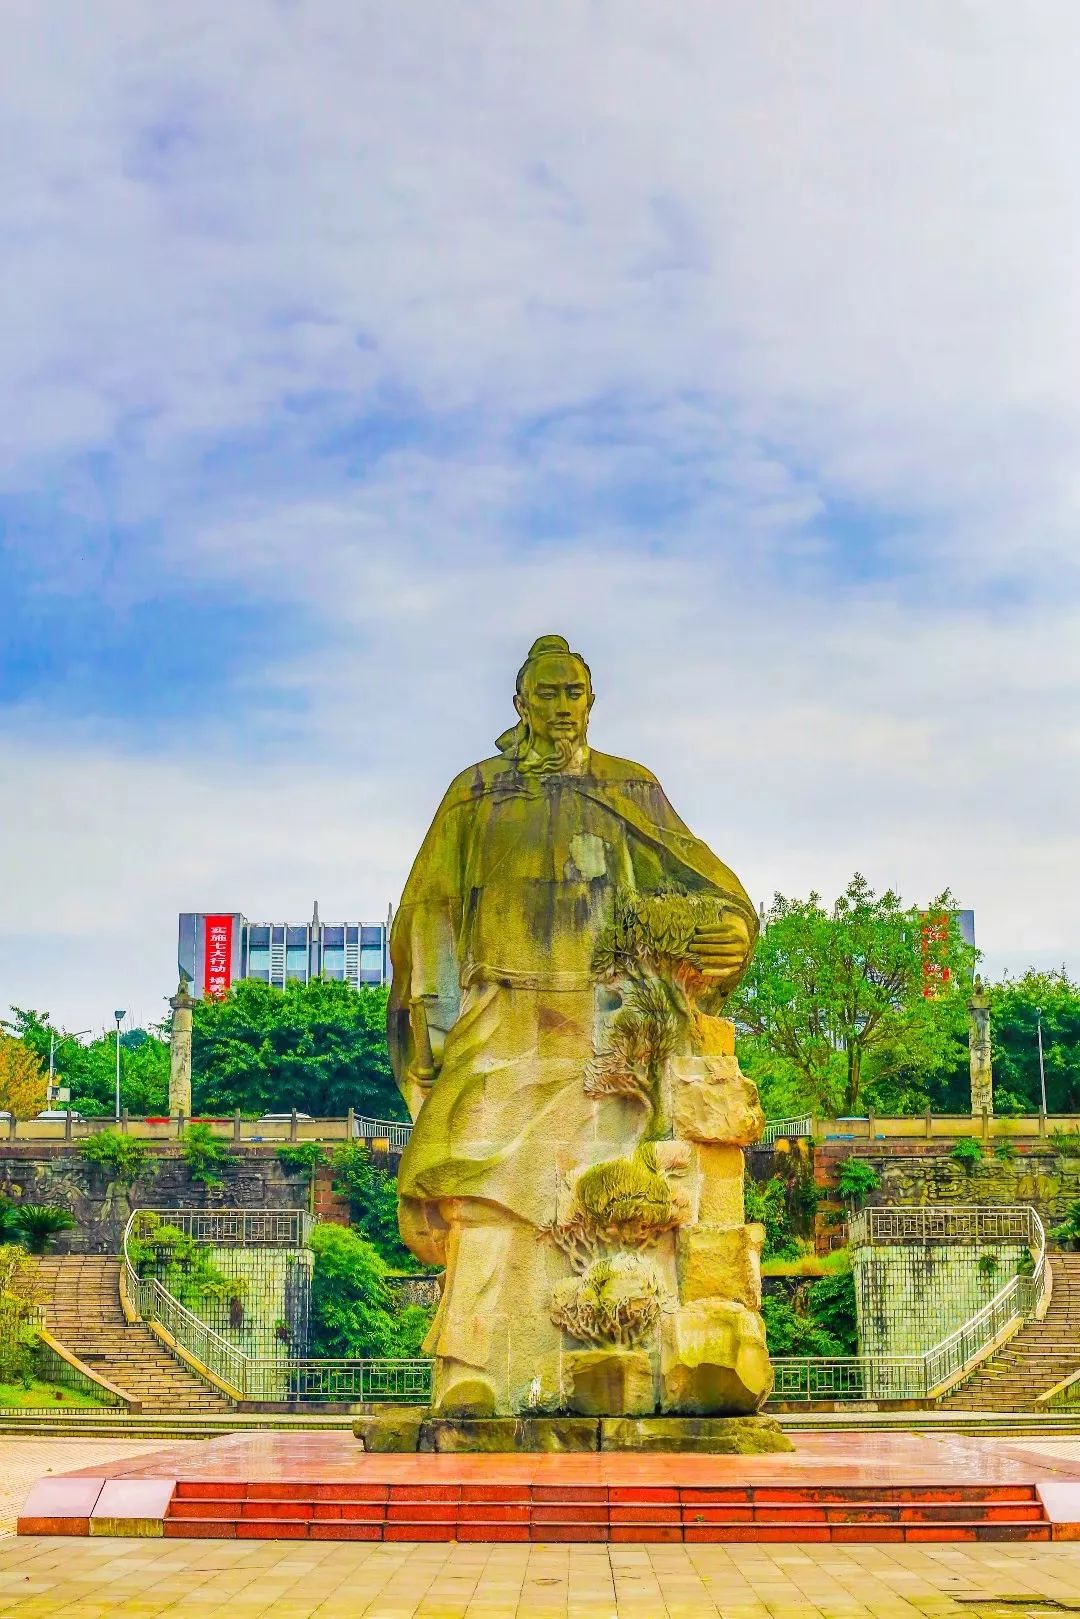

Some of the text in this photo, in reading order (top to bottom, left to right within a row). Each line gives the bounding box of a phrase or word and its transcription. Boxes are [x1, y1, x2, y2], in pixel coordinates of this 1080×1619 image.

[209, 927, 227, 972] 实施七大行动
